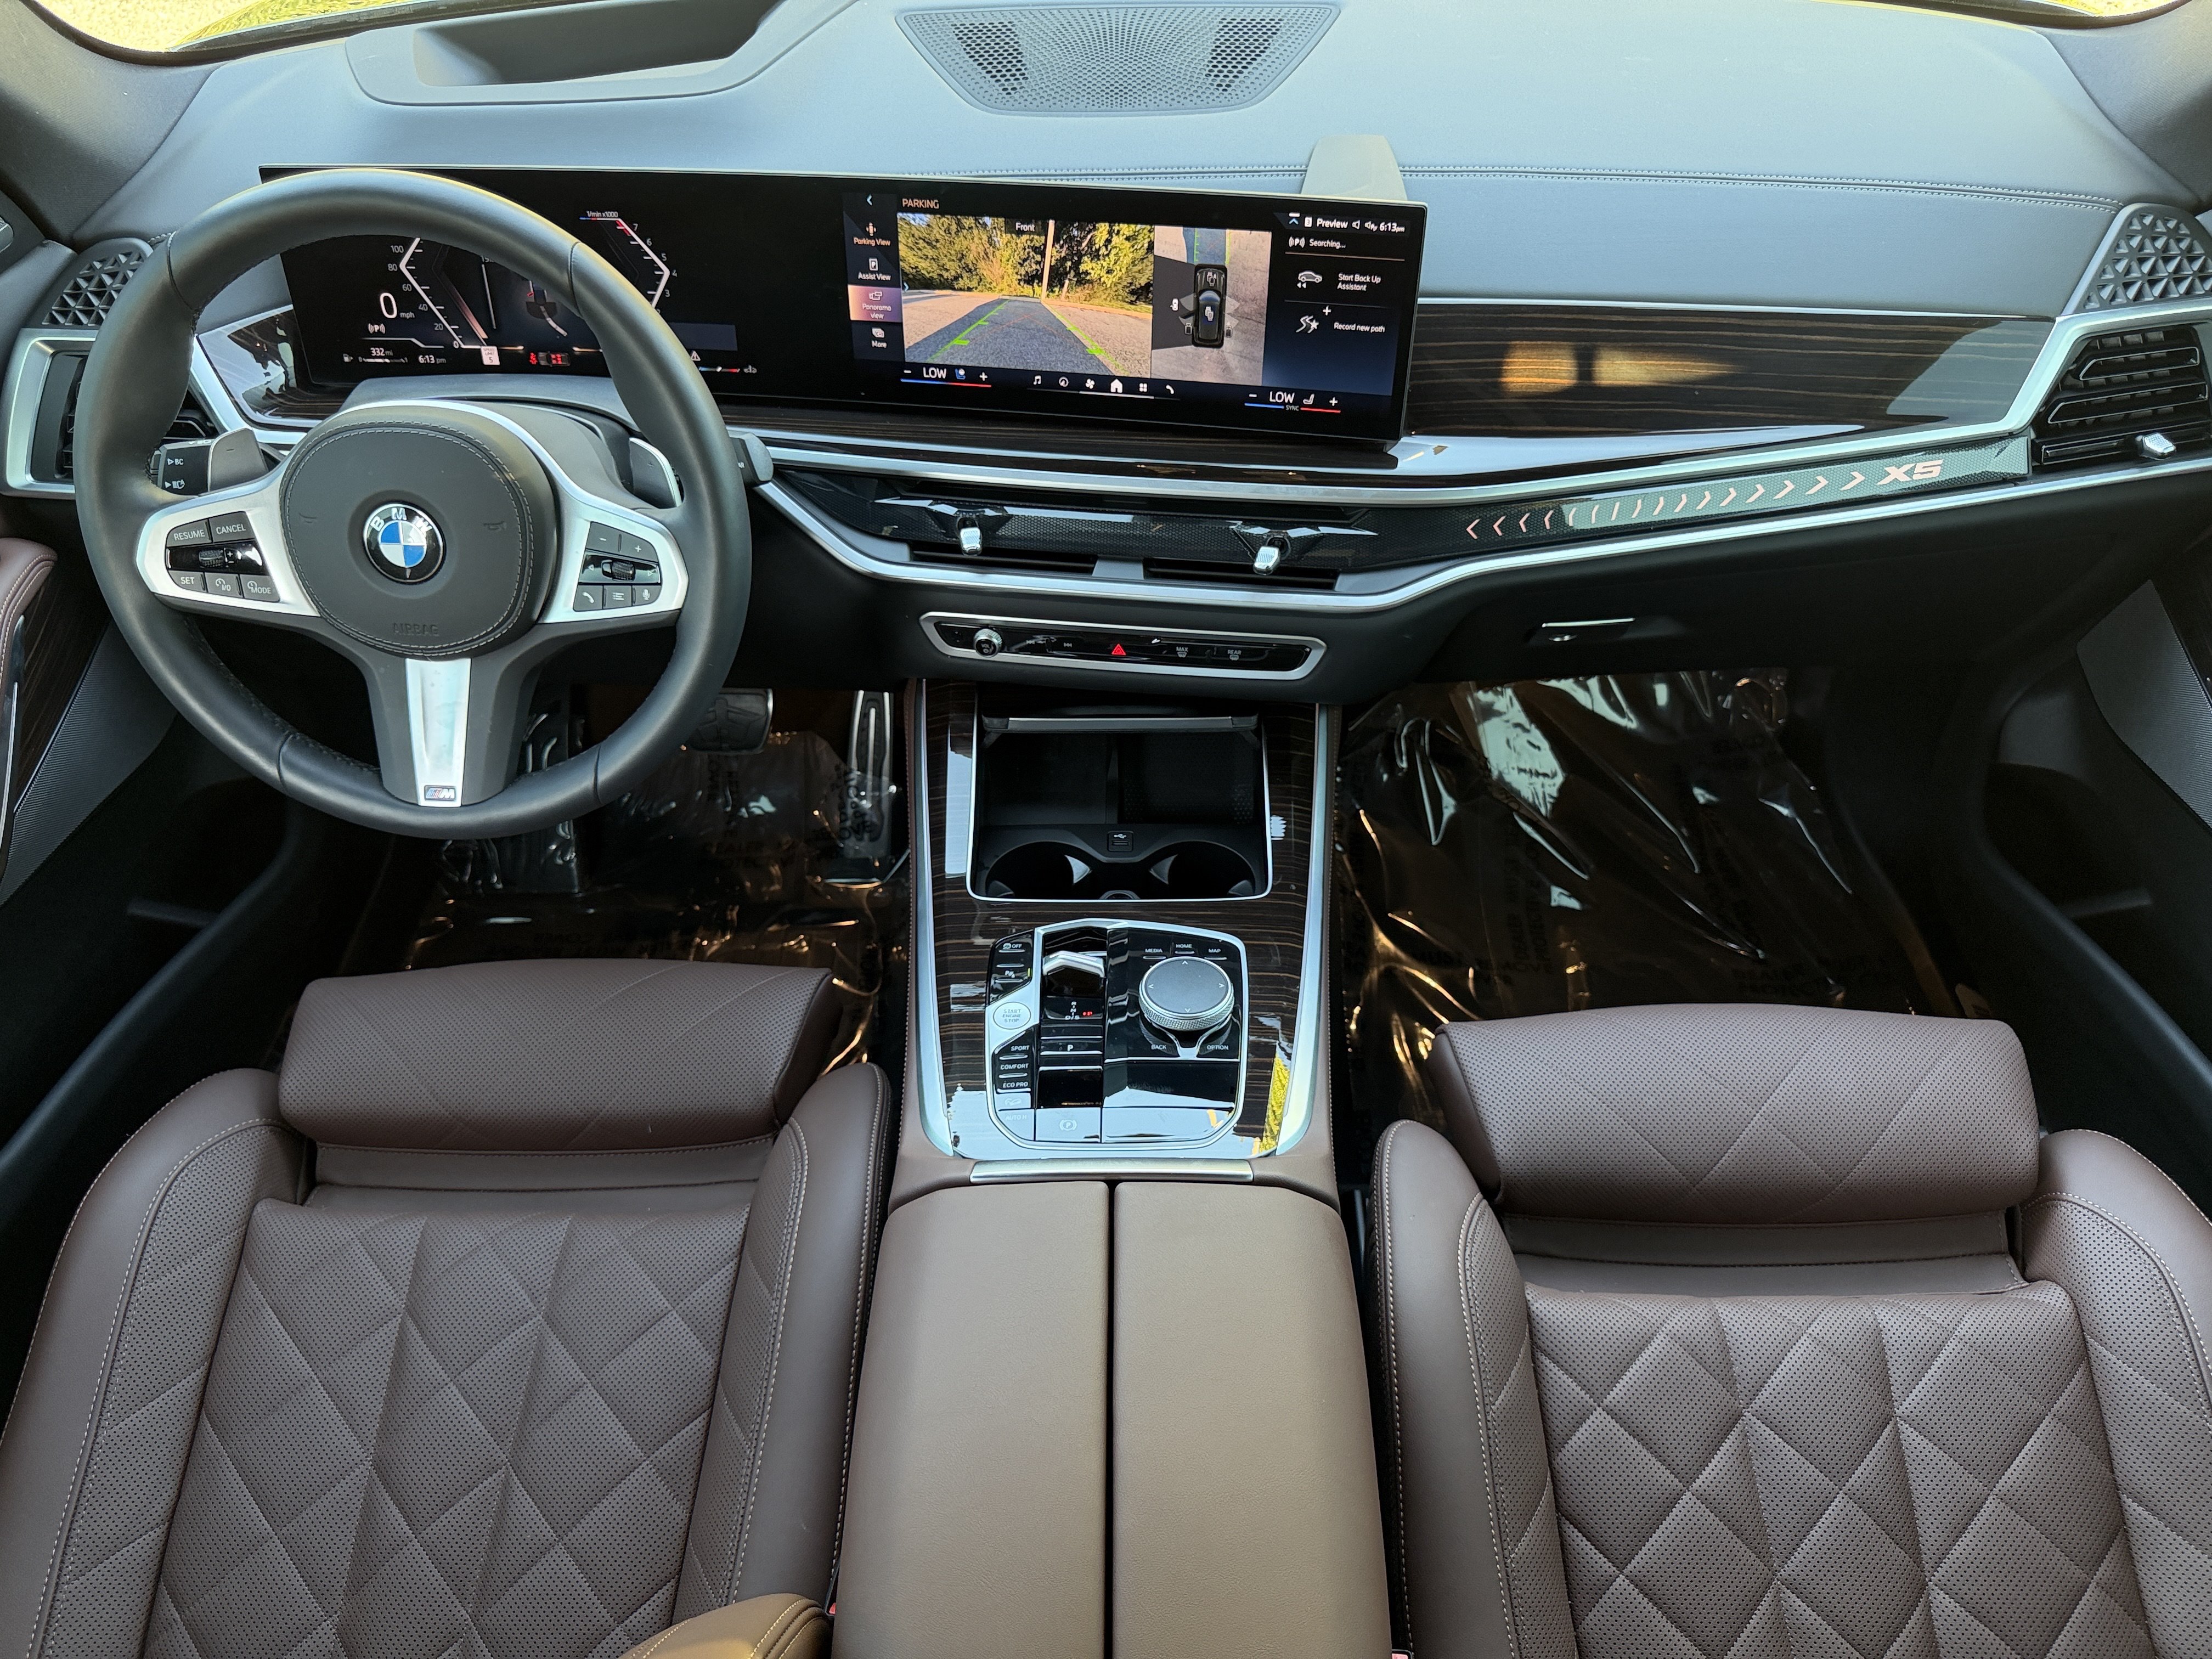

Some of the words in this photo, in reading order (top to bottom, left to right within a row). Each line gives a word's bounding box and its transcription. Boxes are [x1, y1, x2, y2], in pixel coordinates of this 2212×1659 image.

[902, 199, 940, 209] PARKING
[1015, 222, 1035, 232] Front
[1317, 218, 1348, 229] Preview
[854, 237, 876, 247] Parking
[876, 238, 891, 246] View
[390, 245, 404, 253] 100
[661, 253, 667, 261] 5
[858, 272, 876, 280] Assist
[1338, 272, 1353, 281] Start
[1355, 274, 1370, 283] Back
[1371, 275, 1381, 284] Up
[402, 284, 411, 292] 60
[1337, 281, 1367, 291] Assistant
[380, 292, 398, 319] 0
[862, 303, 892, 312] Panorama
[1334, 322, 1356, 331] Record
[1370, 325, 1385, 334] path
[871, 340, 887, 348] More
[370, 347, 385, 356] 332
[418, 355, 435, 364] 6:13
[923, 366, 947, 379] LOW
[1269, 391, 1295, 404] LOW
[1876, 459, 1944, 486] X5
[370, 507, 433, 537] BMW
[216, 523, 246, 535] CANCEL
[173, 529, 206, 541] RESUME
[180, 577, 195, 585] SET
[251, 586, 272, 595] MODE
